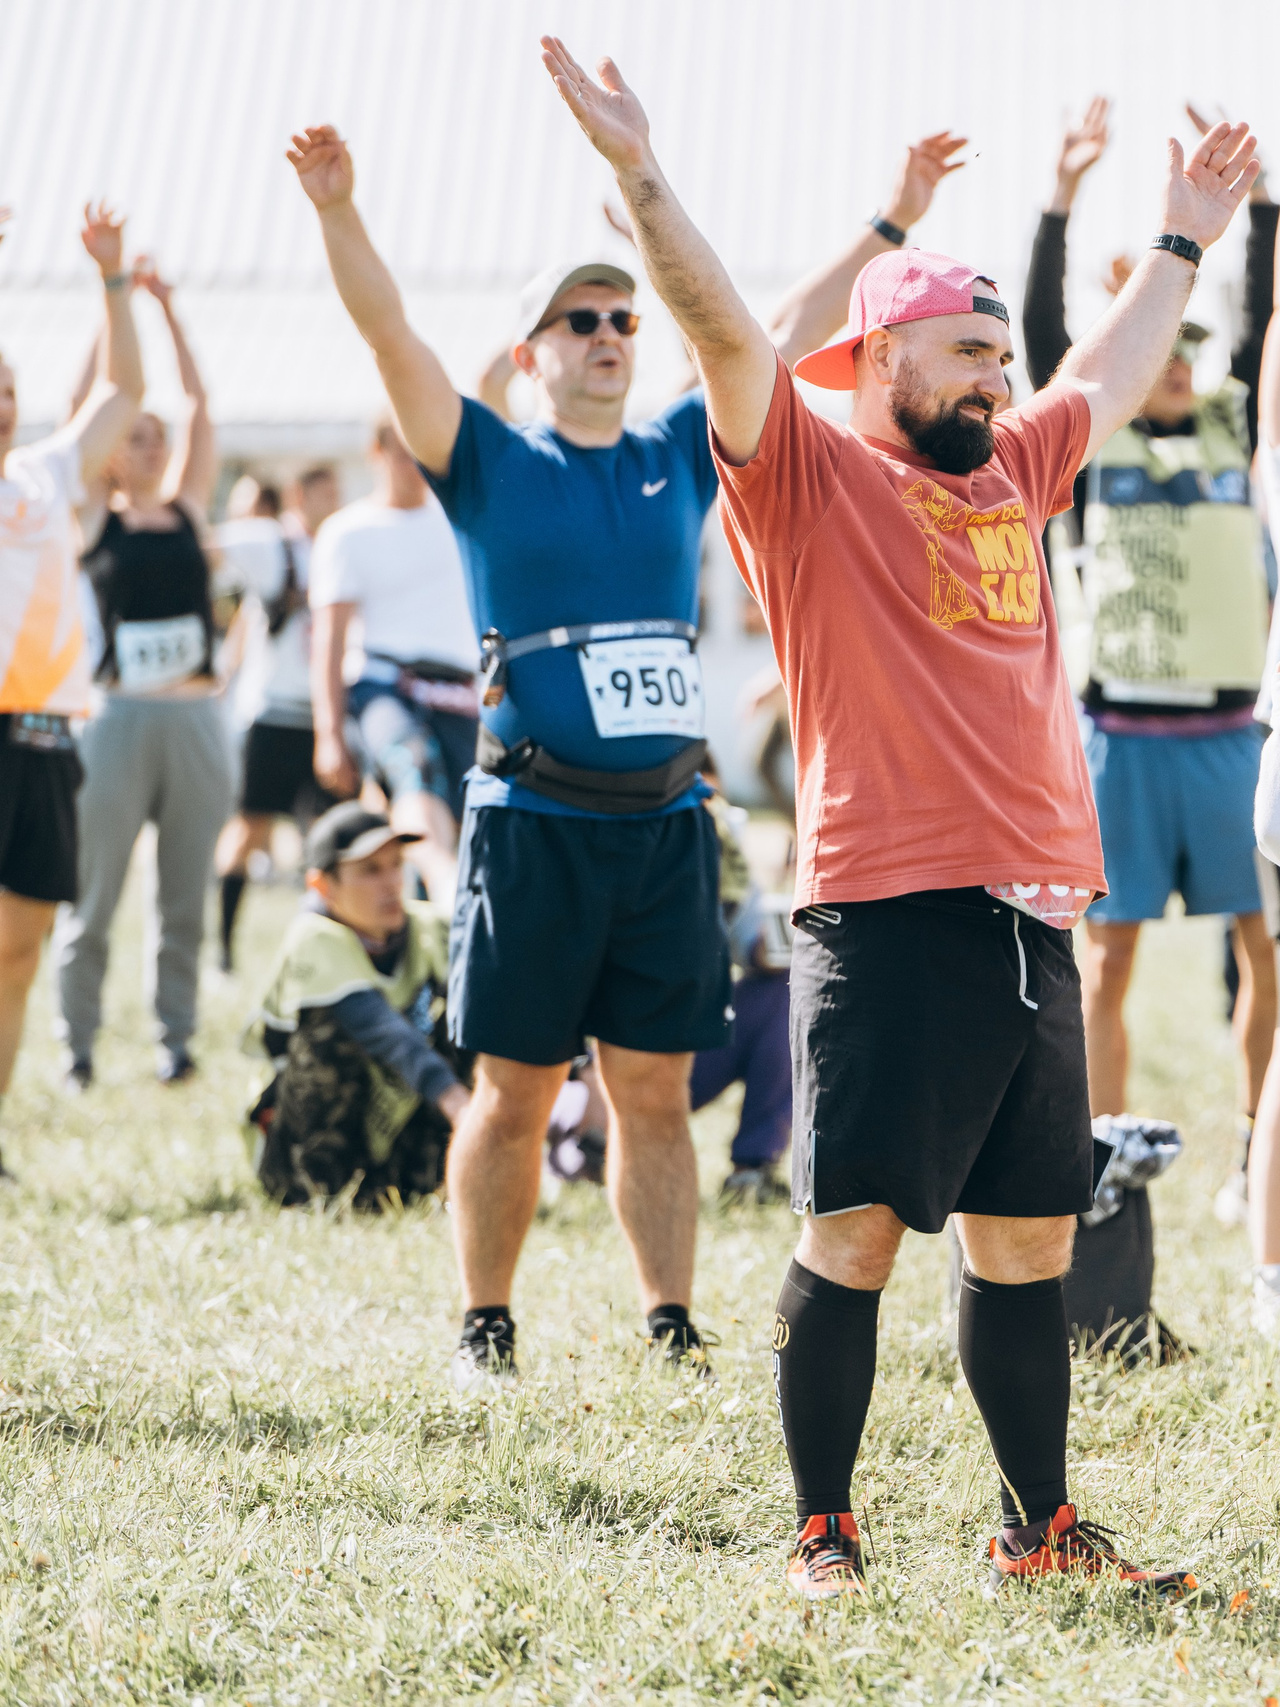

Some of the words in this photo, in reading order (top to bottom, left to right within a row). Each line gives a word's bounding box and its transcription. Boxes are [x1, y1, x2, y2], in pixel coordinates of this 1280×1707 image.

[968, 510, 1001, 524] new
[966, 521, 1038, 572] MOV
[611, 667, 687, 708] 950
